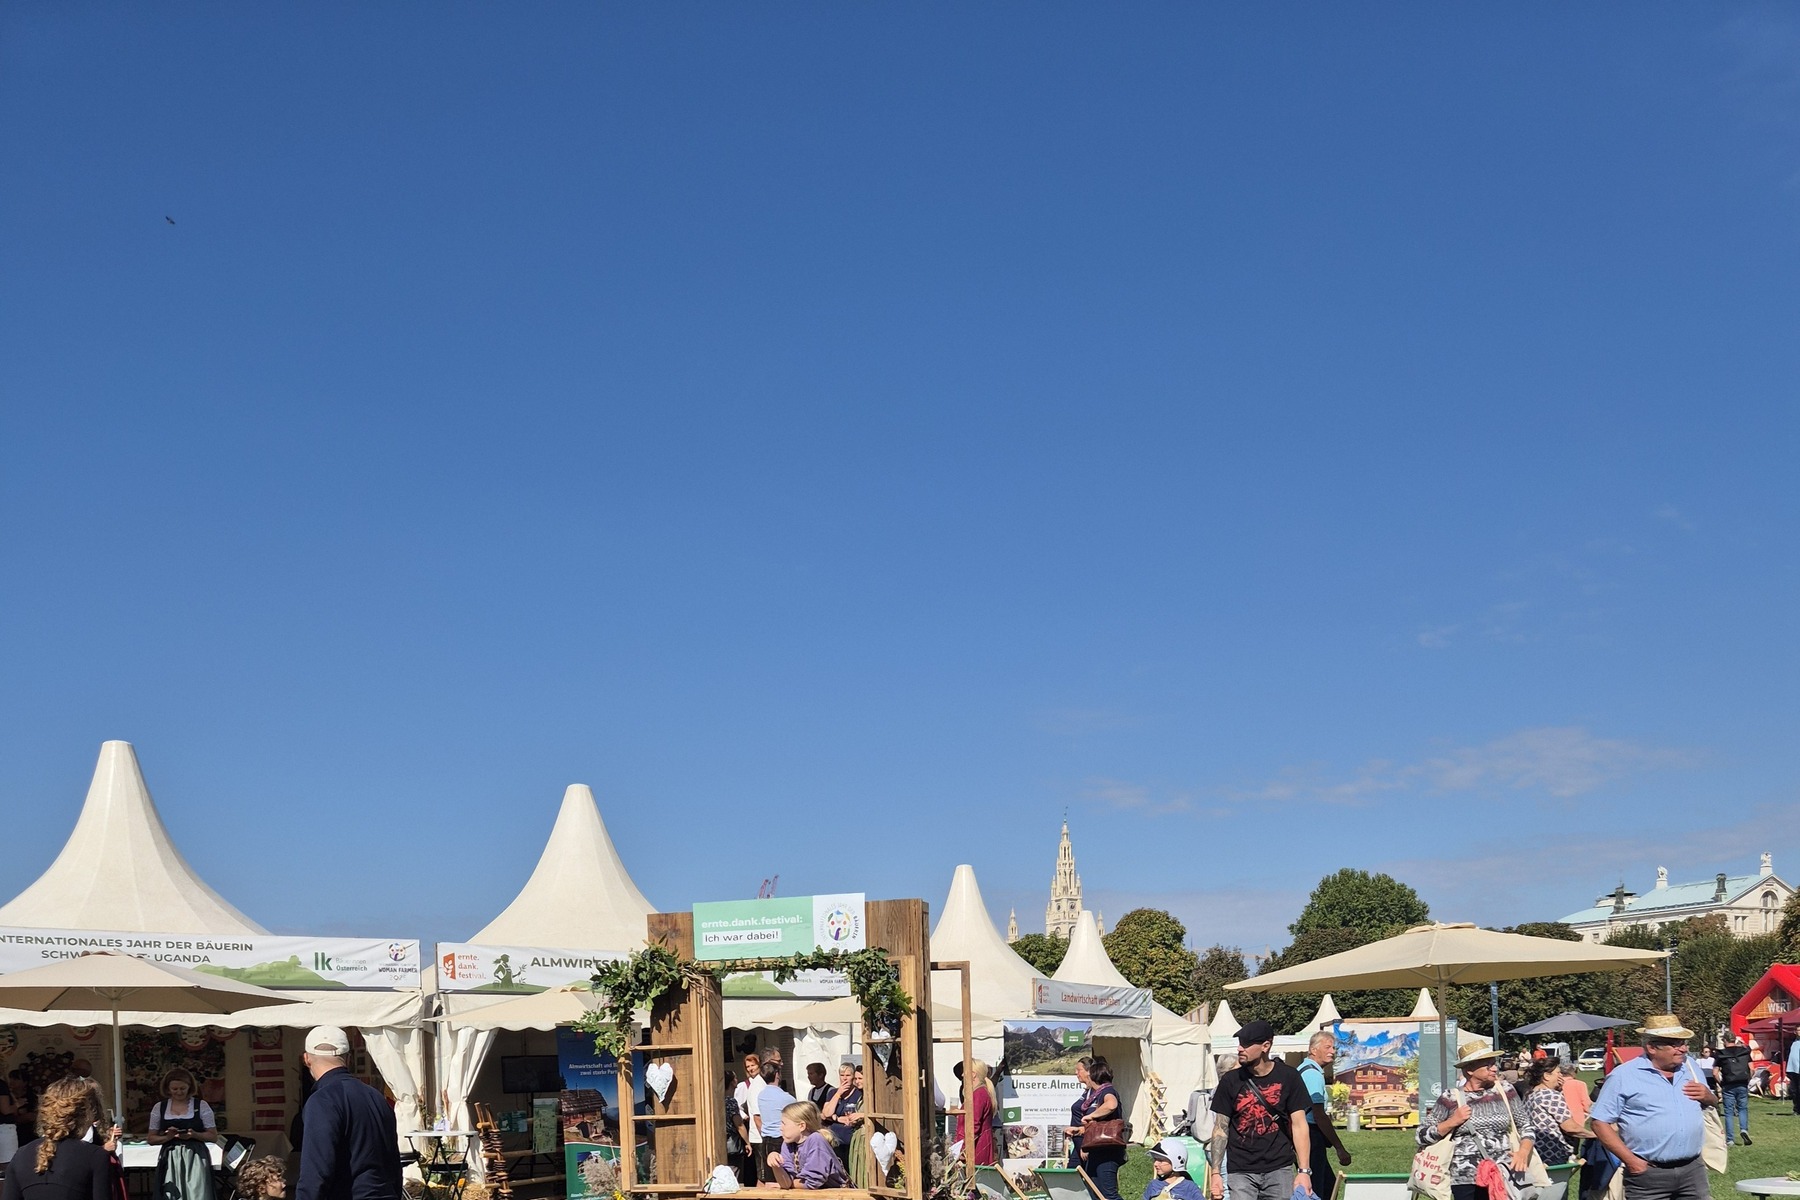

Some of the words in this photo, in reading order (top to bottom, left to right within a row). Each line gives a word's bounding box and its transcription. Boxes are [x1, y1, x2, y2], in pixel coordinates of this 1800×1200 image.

[702, 914, 803, 928] ernte.dank.festival:
[705, 932, 720, 943] Ich
[723, 932, 744, 942] war
[747, 930, 779, 941] dabei!
[126, 939, 162, 949] JAHR
[165, 941, 193, 950] DER
[196, 940, 254, 951] BÄUERIN
[154, 953, 211, 963] UGANDA
[458, 962, 479, 970] dank.
[458, 972, 487, 980] festival.
[1767, 1001, 1791, 1013] WERT
